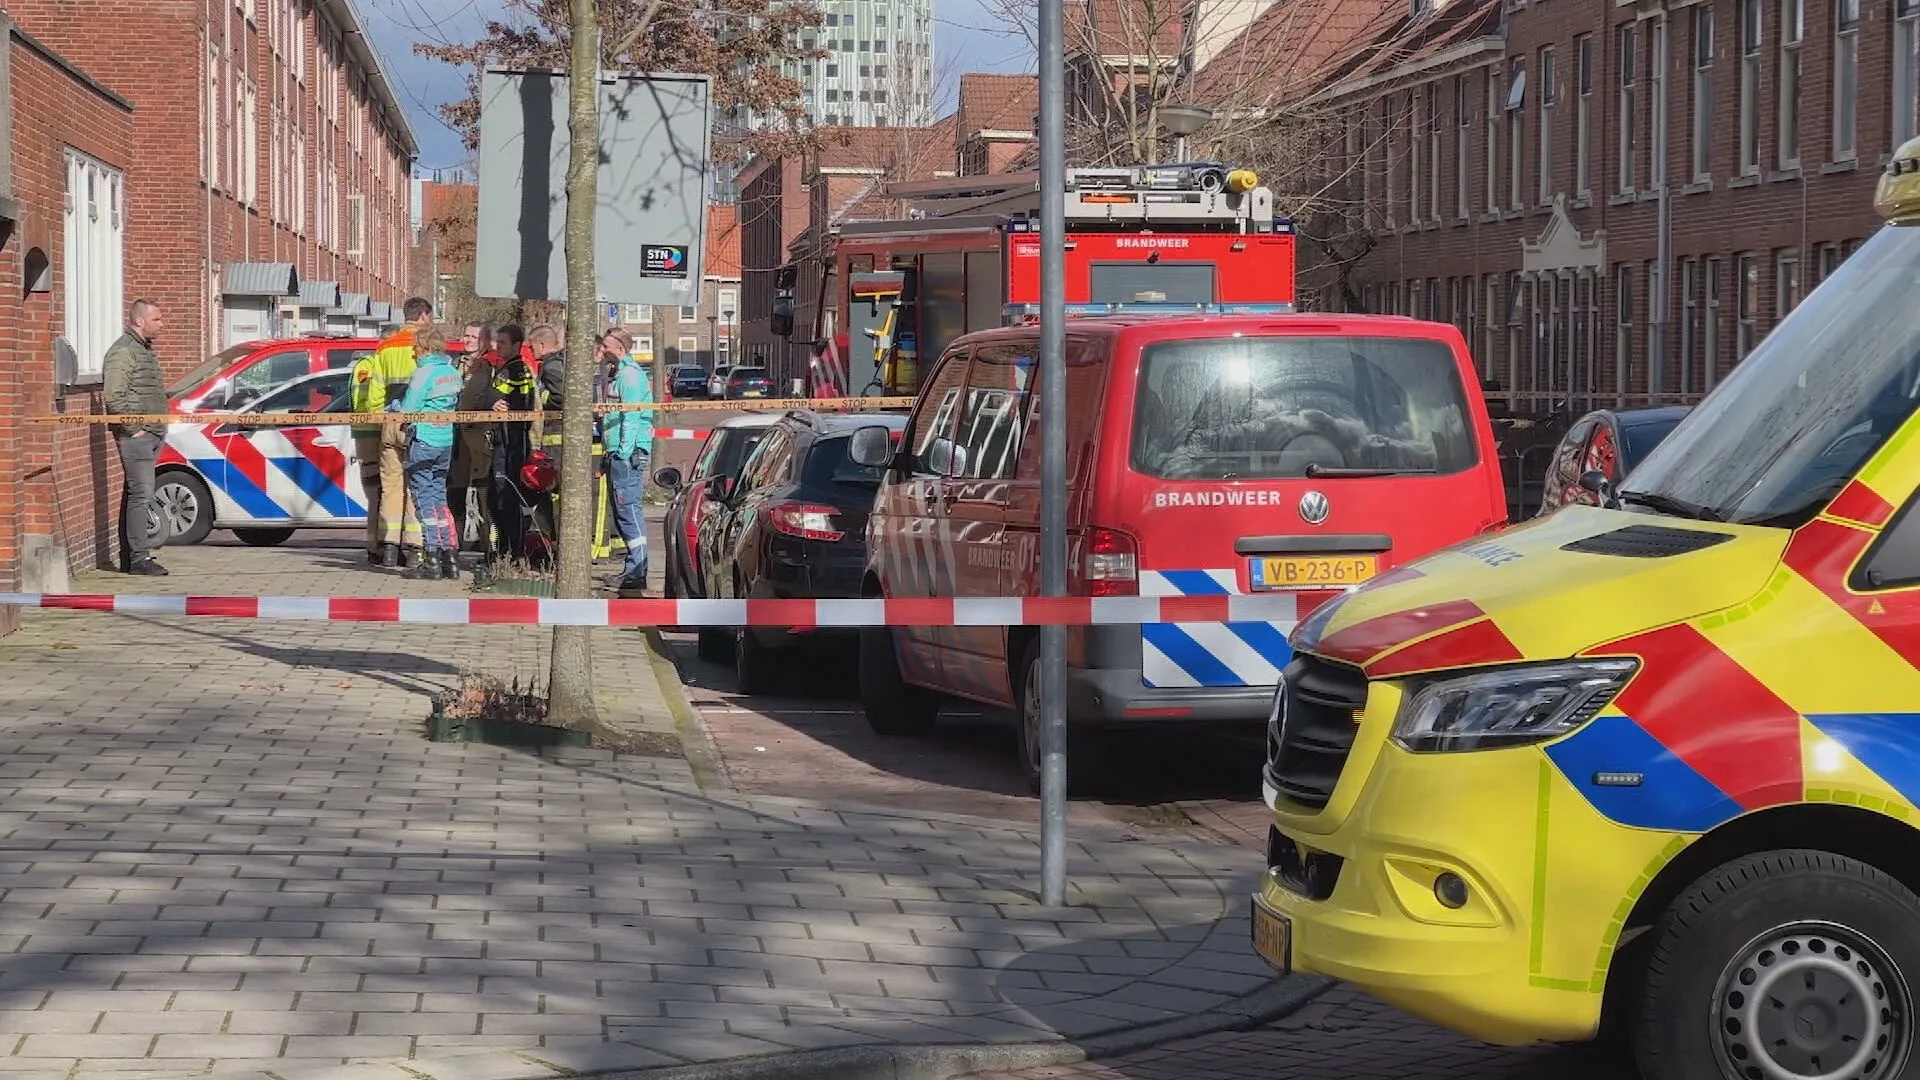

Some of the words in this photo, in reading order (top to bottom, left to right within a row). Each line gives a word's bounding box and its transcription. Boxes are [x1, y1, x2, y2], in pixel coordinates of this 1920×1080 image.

[1116, 238, 1189, 248] BRANDWEER
[647, 249, 669, 260] STN
[661, 404, 686, 412] STOP
[722, 402, 747, 410] STOP
[782, 401, 808, 409] STOP
[842, 400, 867, 408] STOP
[119, 416, 145, 424] STOP
[179, 416, 204, 424] STOP
[238, 416, 261, 424] STOP
[294, 415, 317, 423] STOP
[350, 414, 372, 423] STOP
[403, 413, 426, 422] STOP
[456, 413, 478, 421] STOP
[507, 412, 529, 420] STOP
[1155, 491, 1281, 508] BRANDWEER
[967, 547, 1016, 571] BRANDWEER
[1270, 560, 1367, 582] VB-236-P
